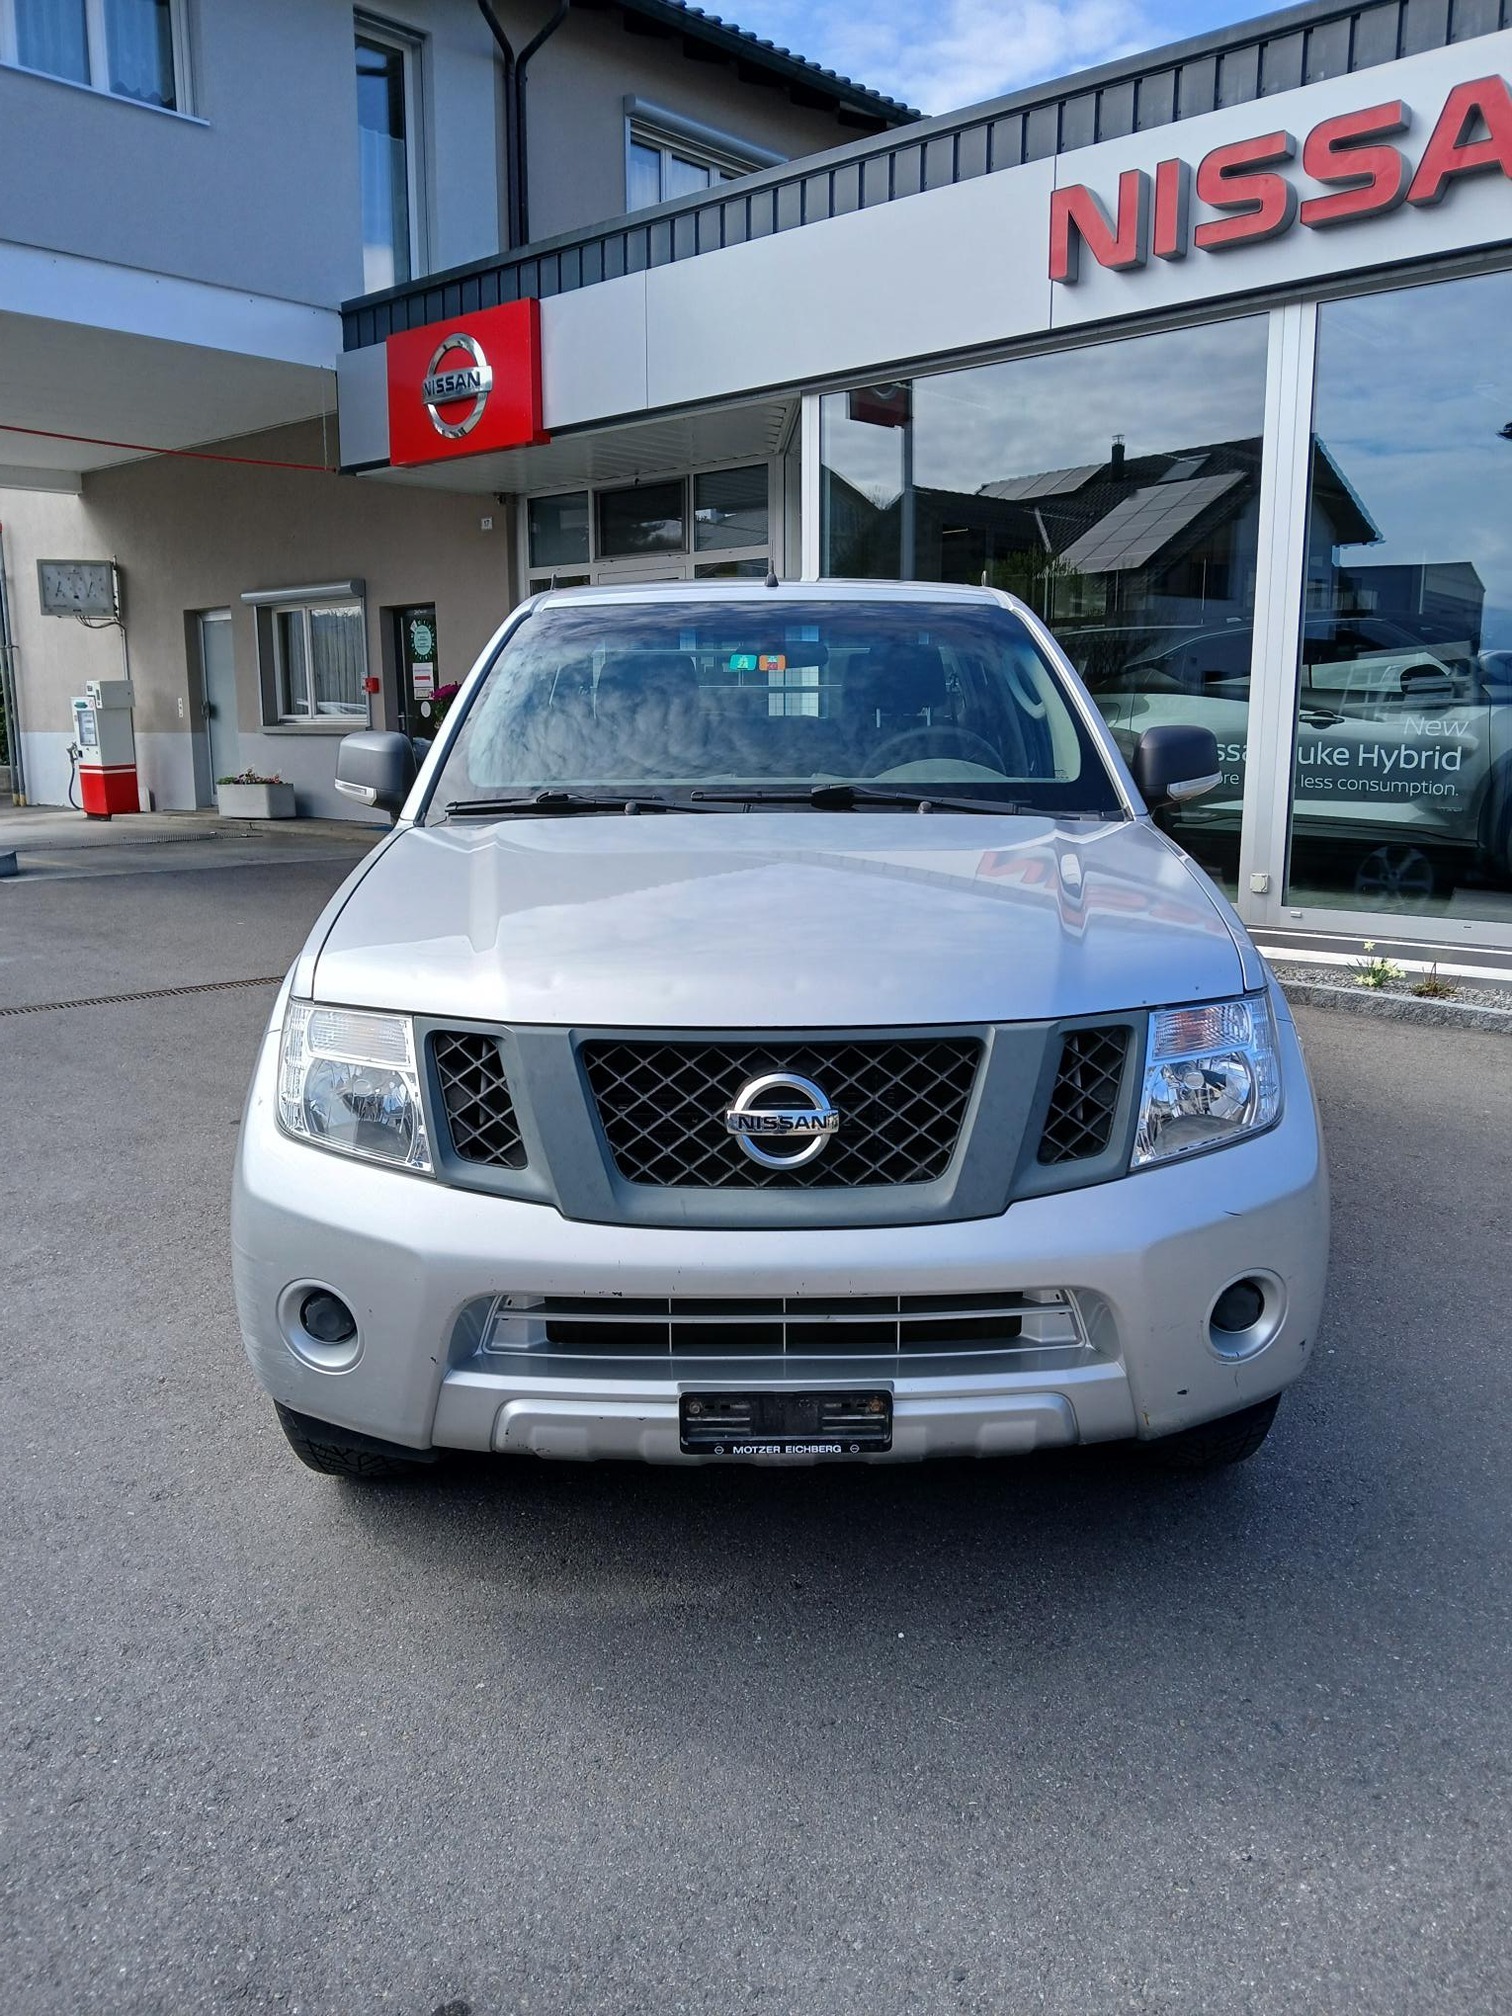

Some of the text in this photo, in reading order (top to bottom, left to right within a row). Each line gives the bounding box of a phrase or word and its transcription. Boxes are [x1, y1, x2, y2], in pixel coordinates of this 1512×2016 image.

[423, 371, 481, 396] NISSAN
[1403, 716, 1469, 737] New
[1297, 741, 1350, 767] uke
[1358, 743, 1462, 775] Hybrid
[1300, 774, 1333, 790] less
[1337, 777, 1459, 797] consumption.
[738, 1115, 828, 1130] NISSAN
[732, 1444, 842, 1455] MOTZER EICHBERG
